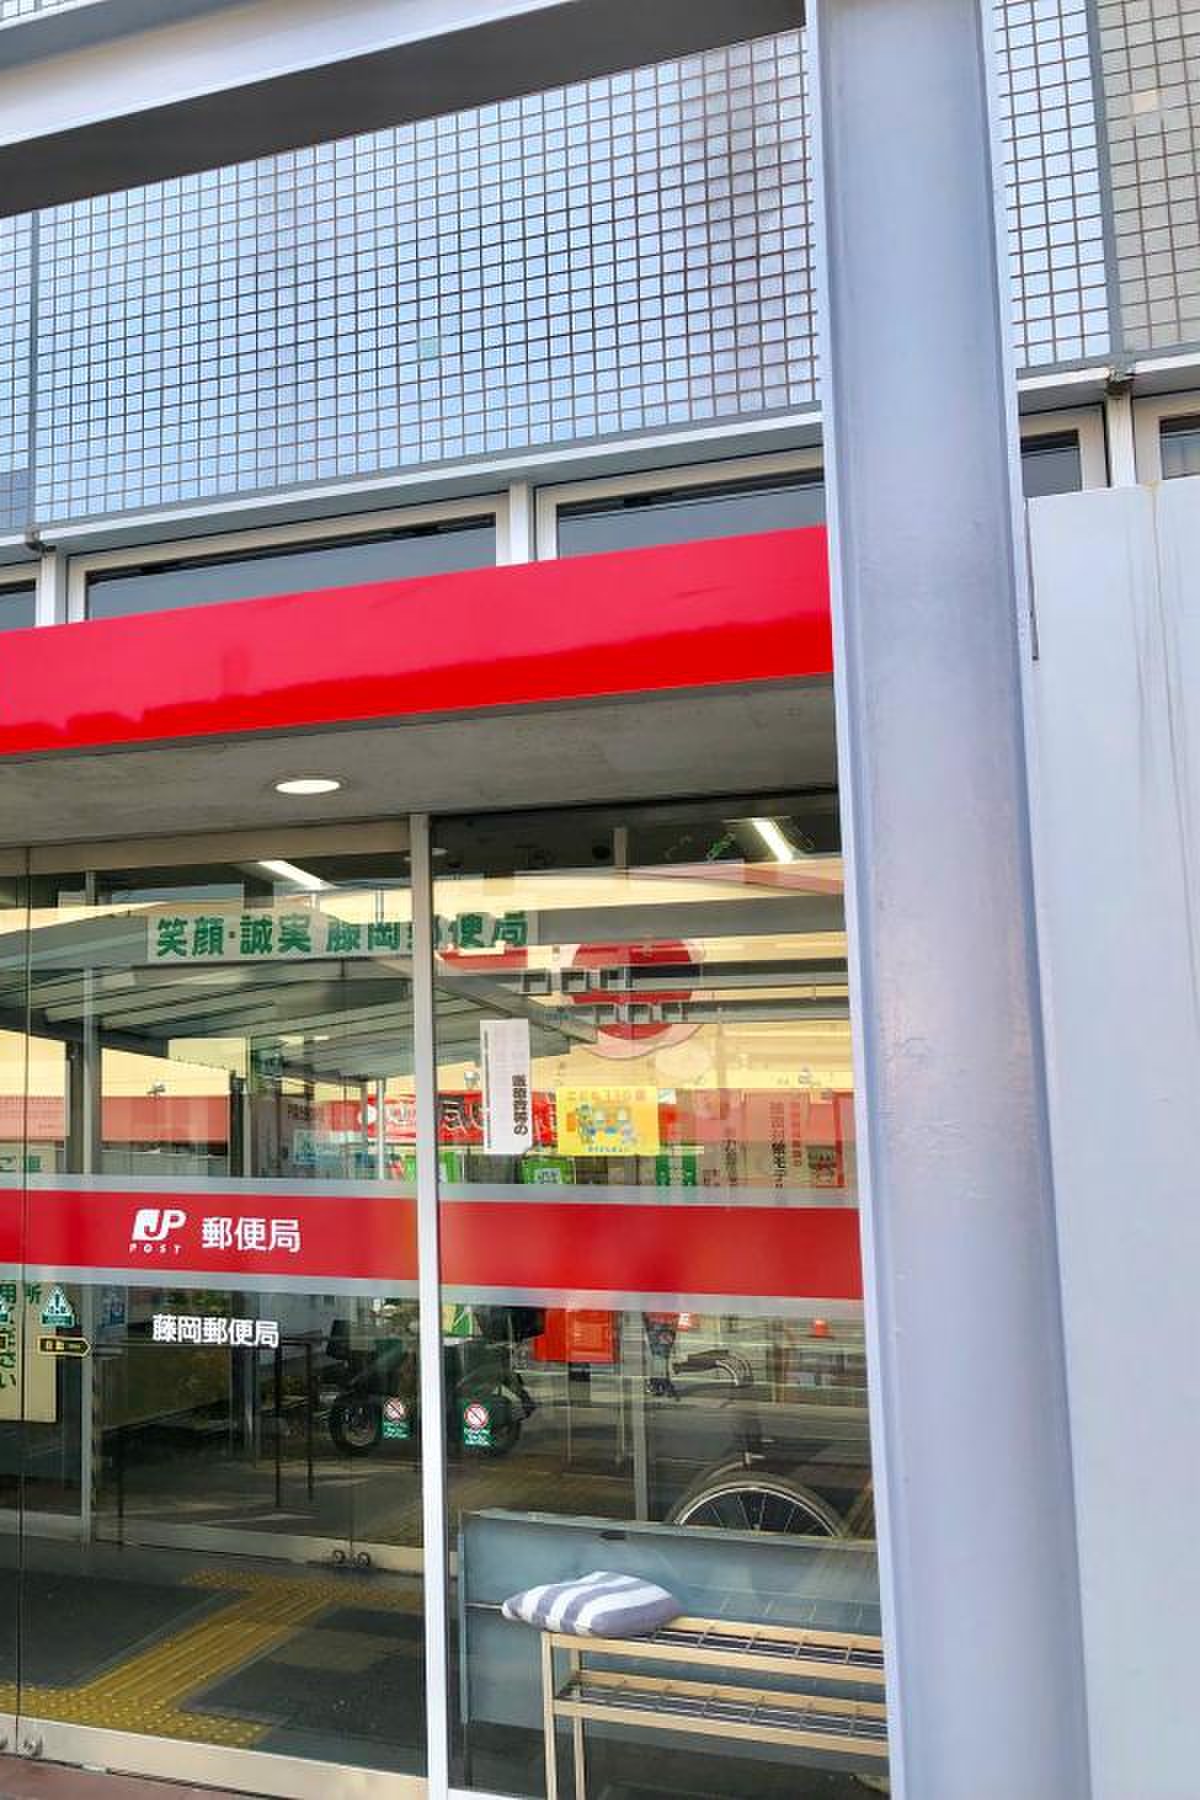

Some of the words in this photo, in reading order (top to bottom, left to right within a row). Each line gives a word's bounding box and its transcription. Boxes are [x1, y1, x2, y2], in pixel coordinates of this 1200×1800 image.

[129, 1243, 182, 1254] POST
[132, 1209, 187, 1241] JP
[202, 1217, 301, 1253] 郵便局
[152, 1313, 280, 1348] 藤岡郵便局
